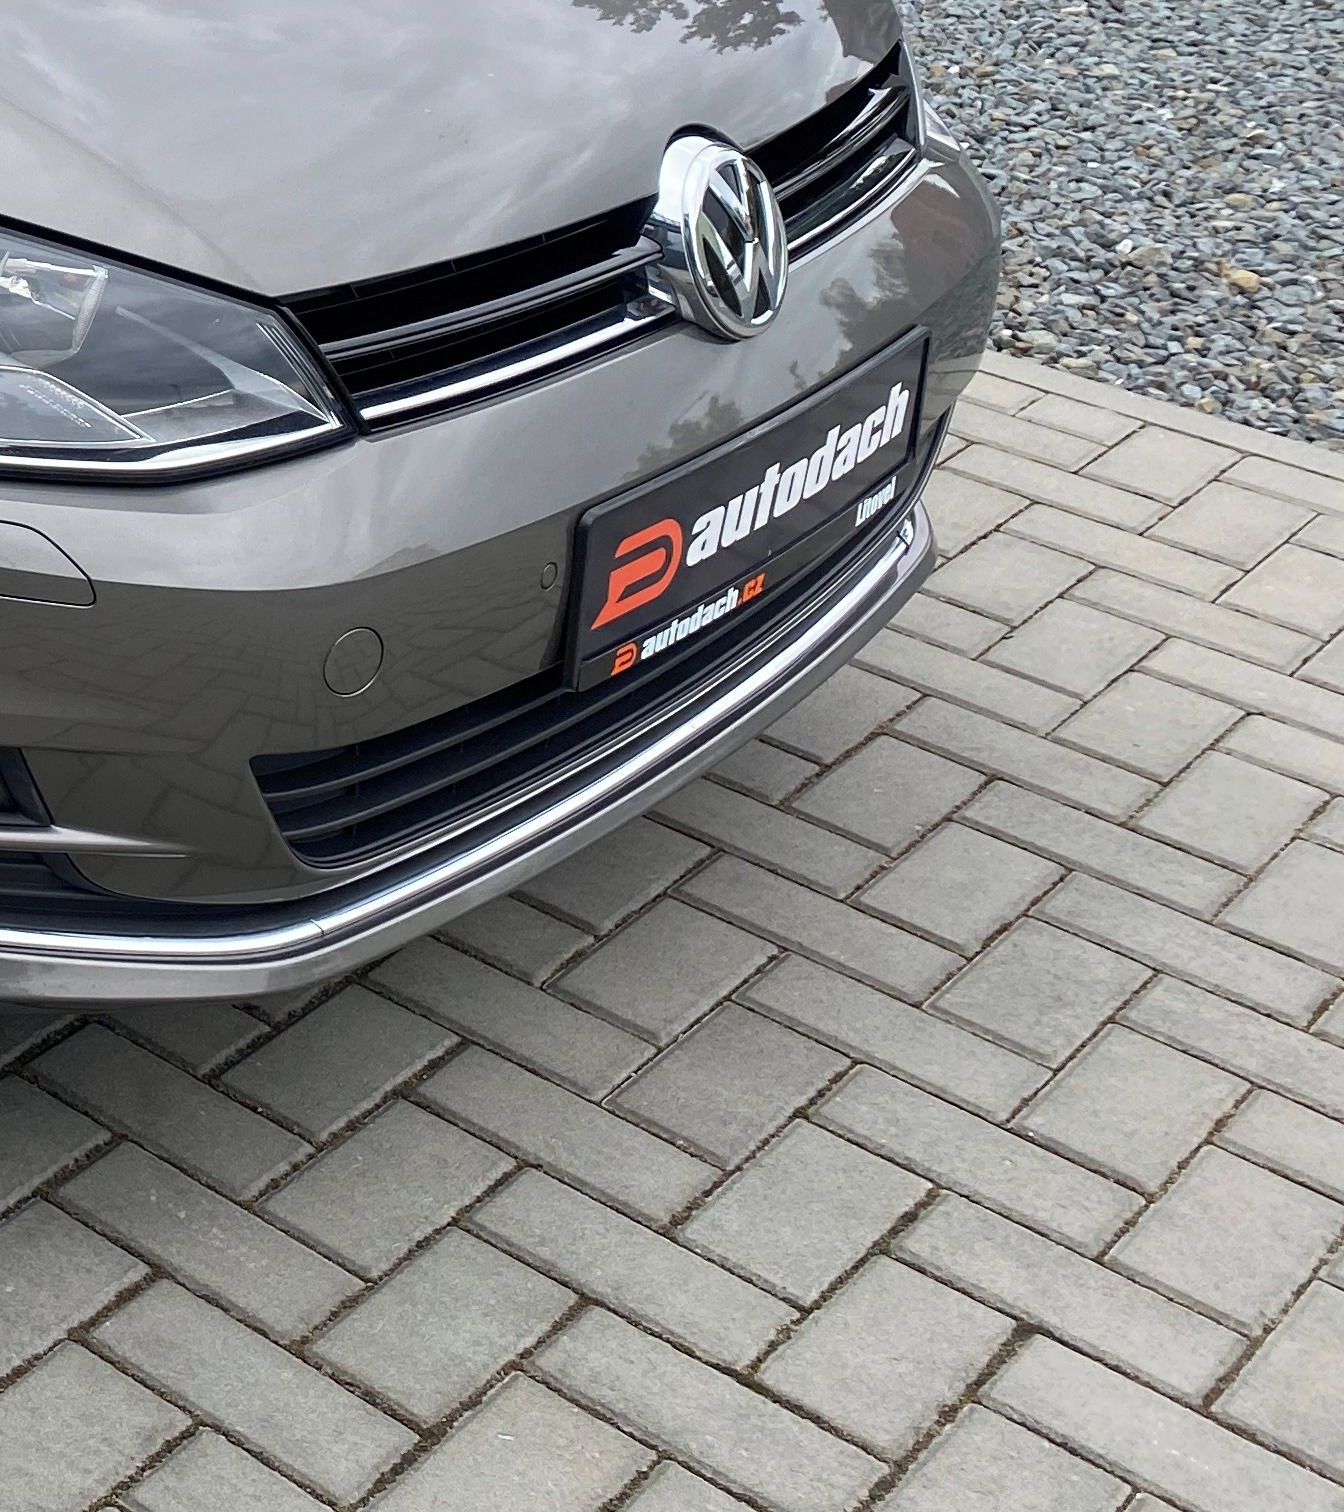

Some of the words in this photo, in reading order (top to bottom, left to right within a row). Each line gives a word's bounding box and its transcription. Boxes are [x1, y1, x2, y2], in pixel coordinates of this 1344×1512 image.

[686, 381, 909, 567] autodach
[855, 475, 896, 527] Litovel
[640, 573, 765, 659] autodach.cz
